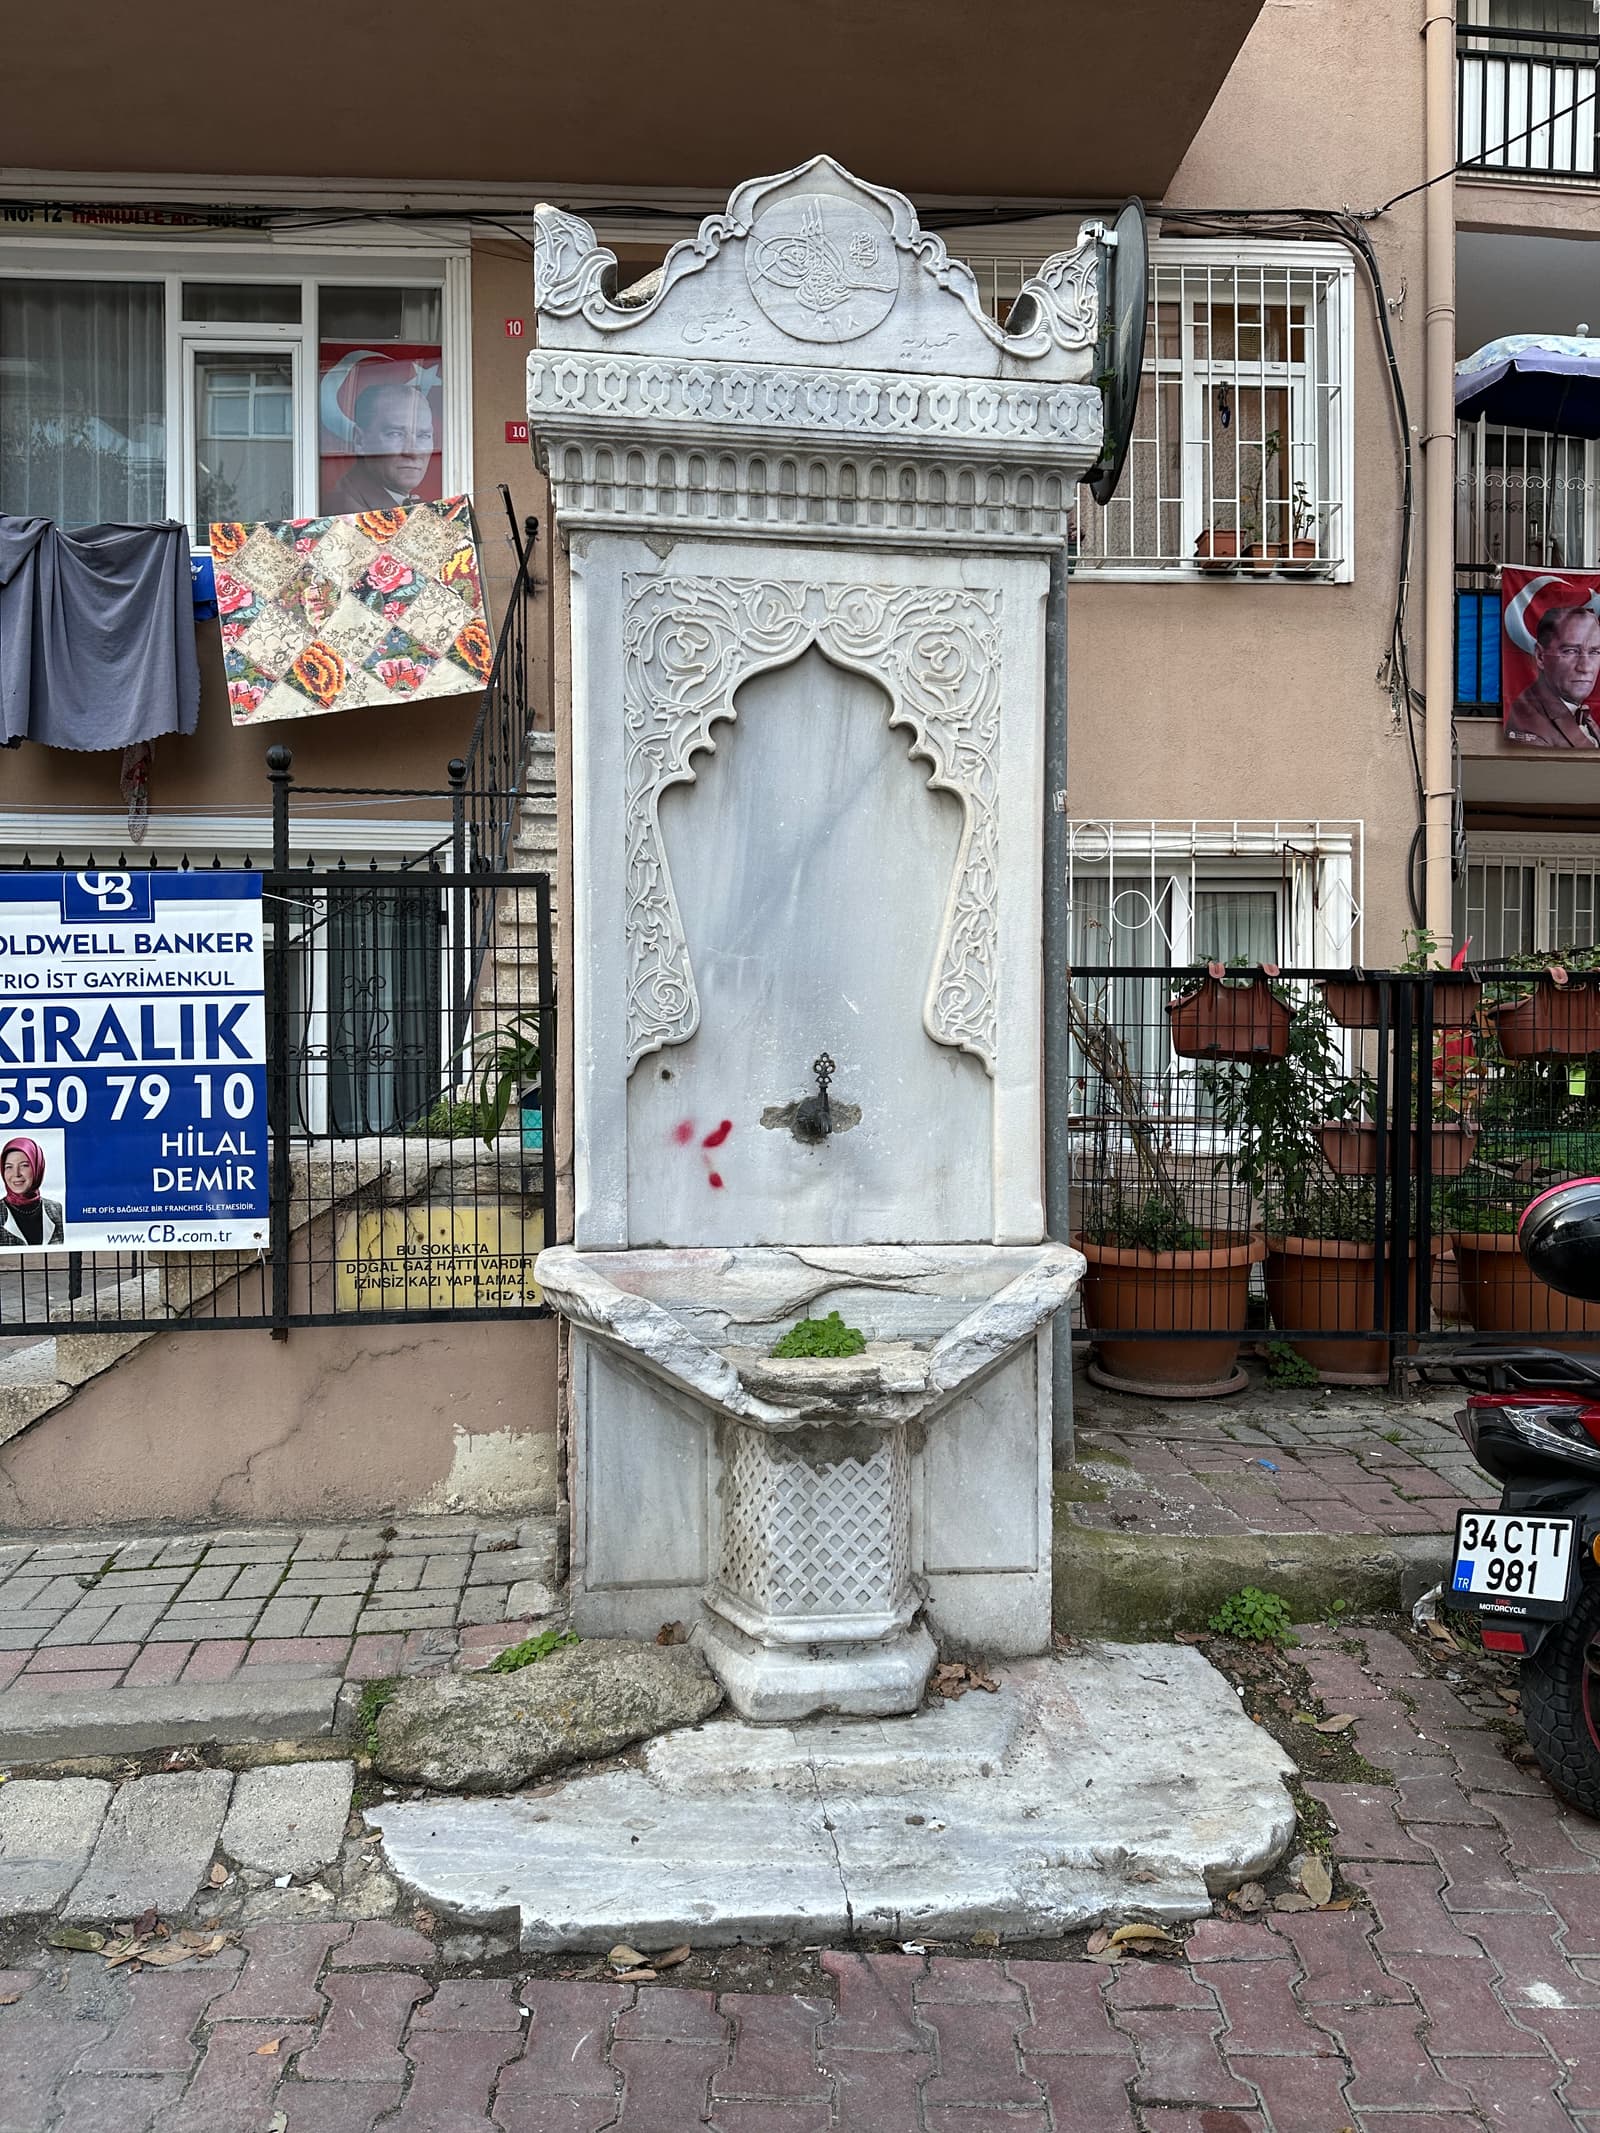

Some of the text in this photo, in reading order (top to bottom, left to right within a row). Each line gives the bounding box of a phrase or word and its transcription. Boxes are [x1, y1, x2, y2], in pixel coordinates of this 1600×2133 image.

[507, 321, 521, 335] 10
[512, 426, 526, 438] 10
[134, 932, 254, 954] BANKER
[0, 967, 235, 989] RIO İST GAYRİMENKUL
[106, 1074, 171, 1120] 79
[194, 1072, 255, 1119] 10
[161, 1125, 256, 1157] HİLAL
[152, 1160, 256, 1193] DEMİR
[98, 1205, 115, 1214] OFİS
[116, 1205, 149, 1213] BAĞIMSIZ
[151, 1203, 163, 1212] BİR
[164, 1204, 204, 1212] FRANCHISE
[107, 1225, 232, 1243] www.CB.com.tr
[396, 1243, 489, 1255] BU SOKAKTA
[403, 1260, 432, 1271] GAZ
[437, 1259, 476, 1270] HATTI
[481, 1258, 533, 1269] VARDIR
[408, 1276, 441, 1287] KAZI
[1462, 1518, 1570, 1557] 34 CTT
[1457, 1577, 1470, 1589] TR
[1485, 1558, 1538, 1594] 981
[1479, 1603, 1527, 1615] MOTORCYCLE
